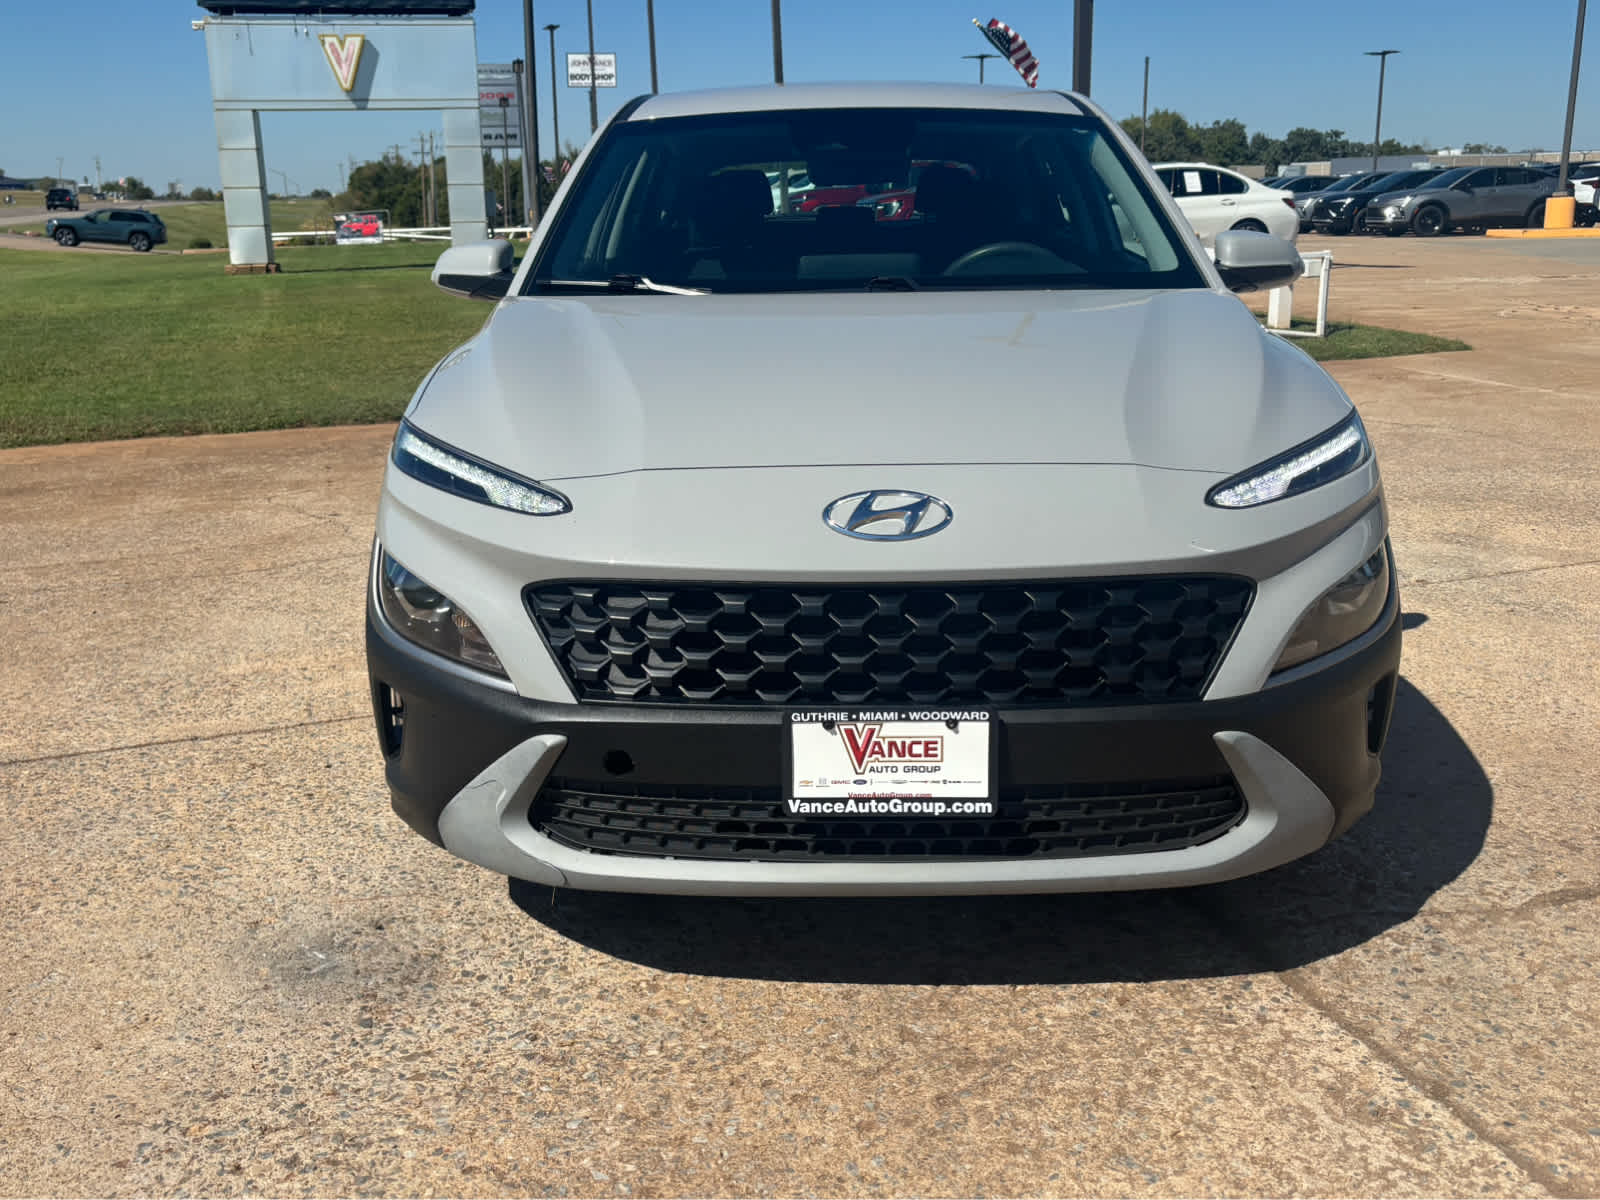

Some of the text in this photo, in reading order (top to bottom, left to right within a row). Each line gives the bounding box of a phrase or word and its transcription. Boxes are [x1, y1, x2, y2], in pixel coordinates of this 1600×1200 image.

[318, 34, 365, 91] V
[570, 73, 591, 81] BODY
[791, 711, 990, 722] GUTHRIE MIAMI WOODWARD
[842, 727, 939, 769] VANCE
[868, 765, 941, 774] AUTO GROUP
[788, 799, 993, 816] VanceAutoGroup.com
